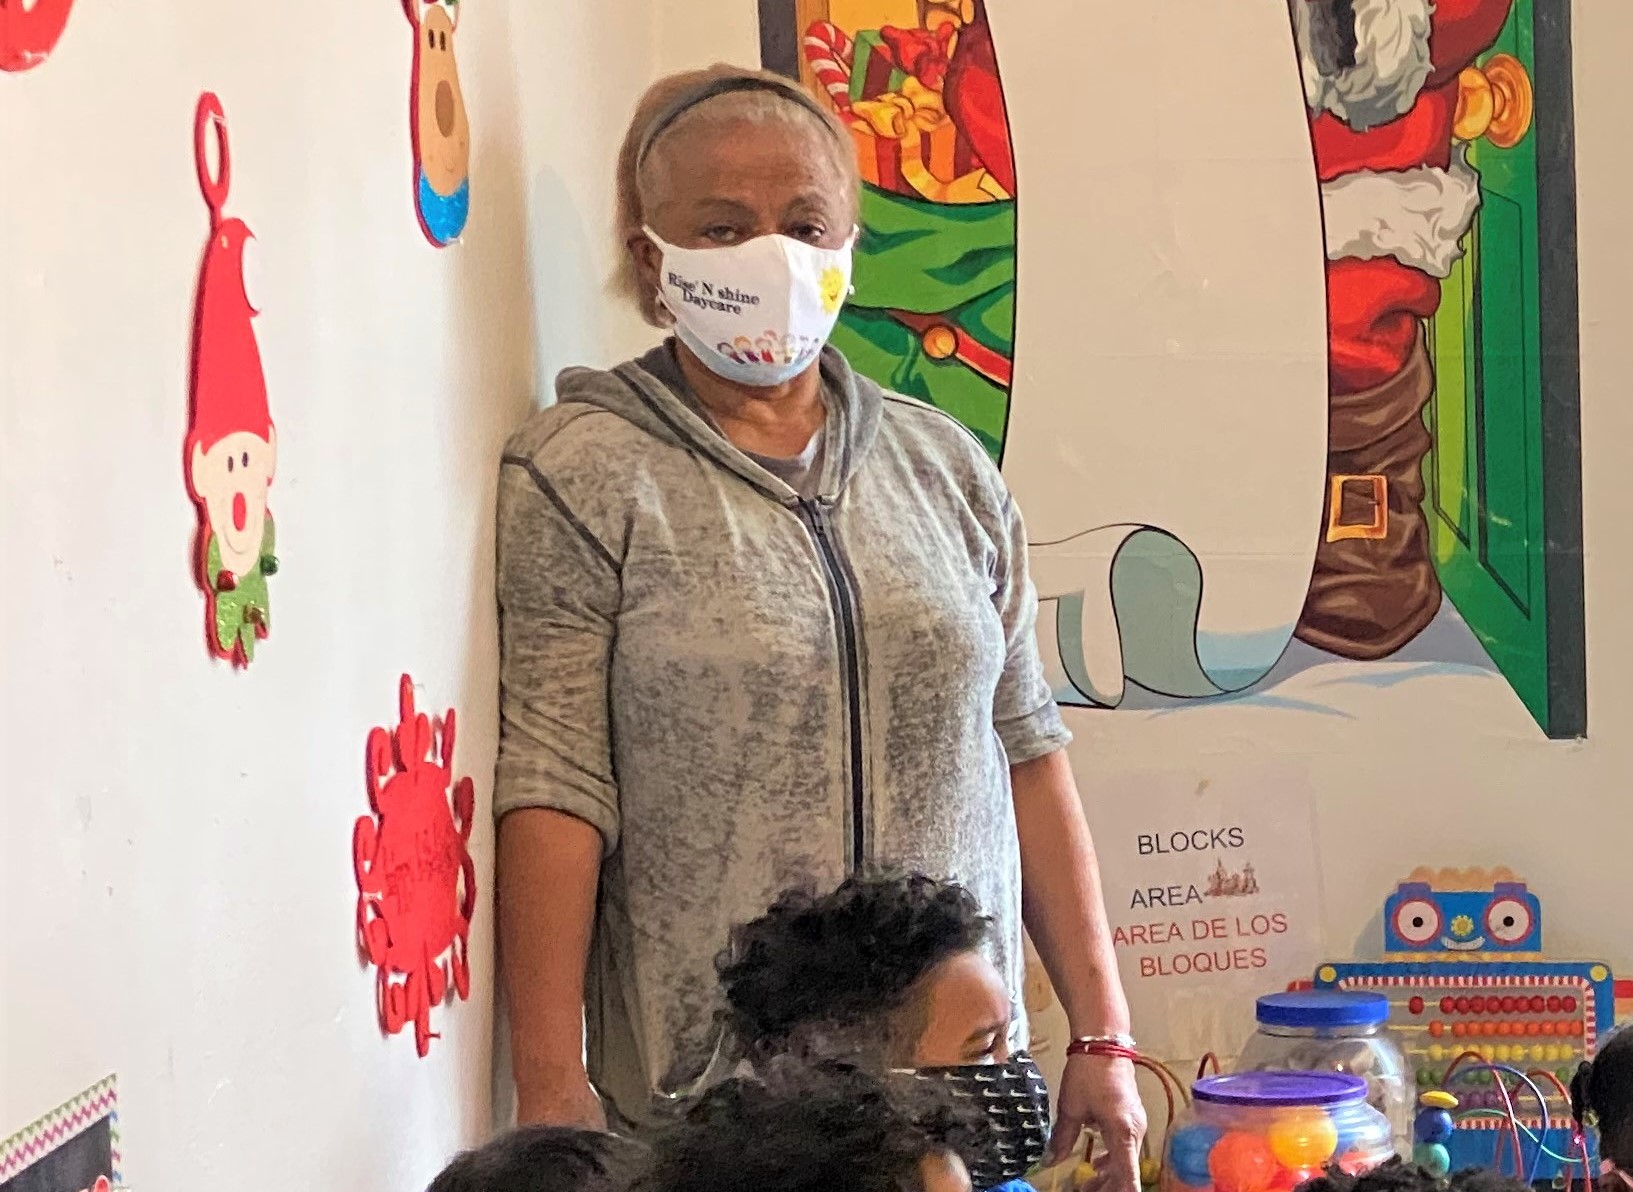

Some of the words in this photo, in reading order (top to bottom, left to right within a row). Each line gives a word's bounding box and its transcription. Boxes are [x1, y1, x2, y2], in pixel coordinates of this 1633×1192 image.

[683, 290, 742, 315] Daycare
[700, 282, 713, 297] N
[718, 283, 760, 305] shine
[1138, 827, 1245, 855] BLOCKS
[1130, 884, 1203, 909] AREA
[1113, 922, 1183, 947] AREA
[1191, 918, 1228, 941] DE
[1236, 913, 1289, 937] LOS
[1140, 948, 1267, 978] BLOQUES
